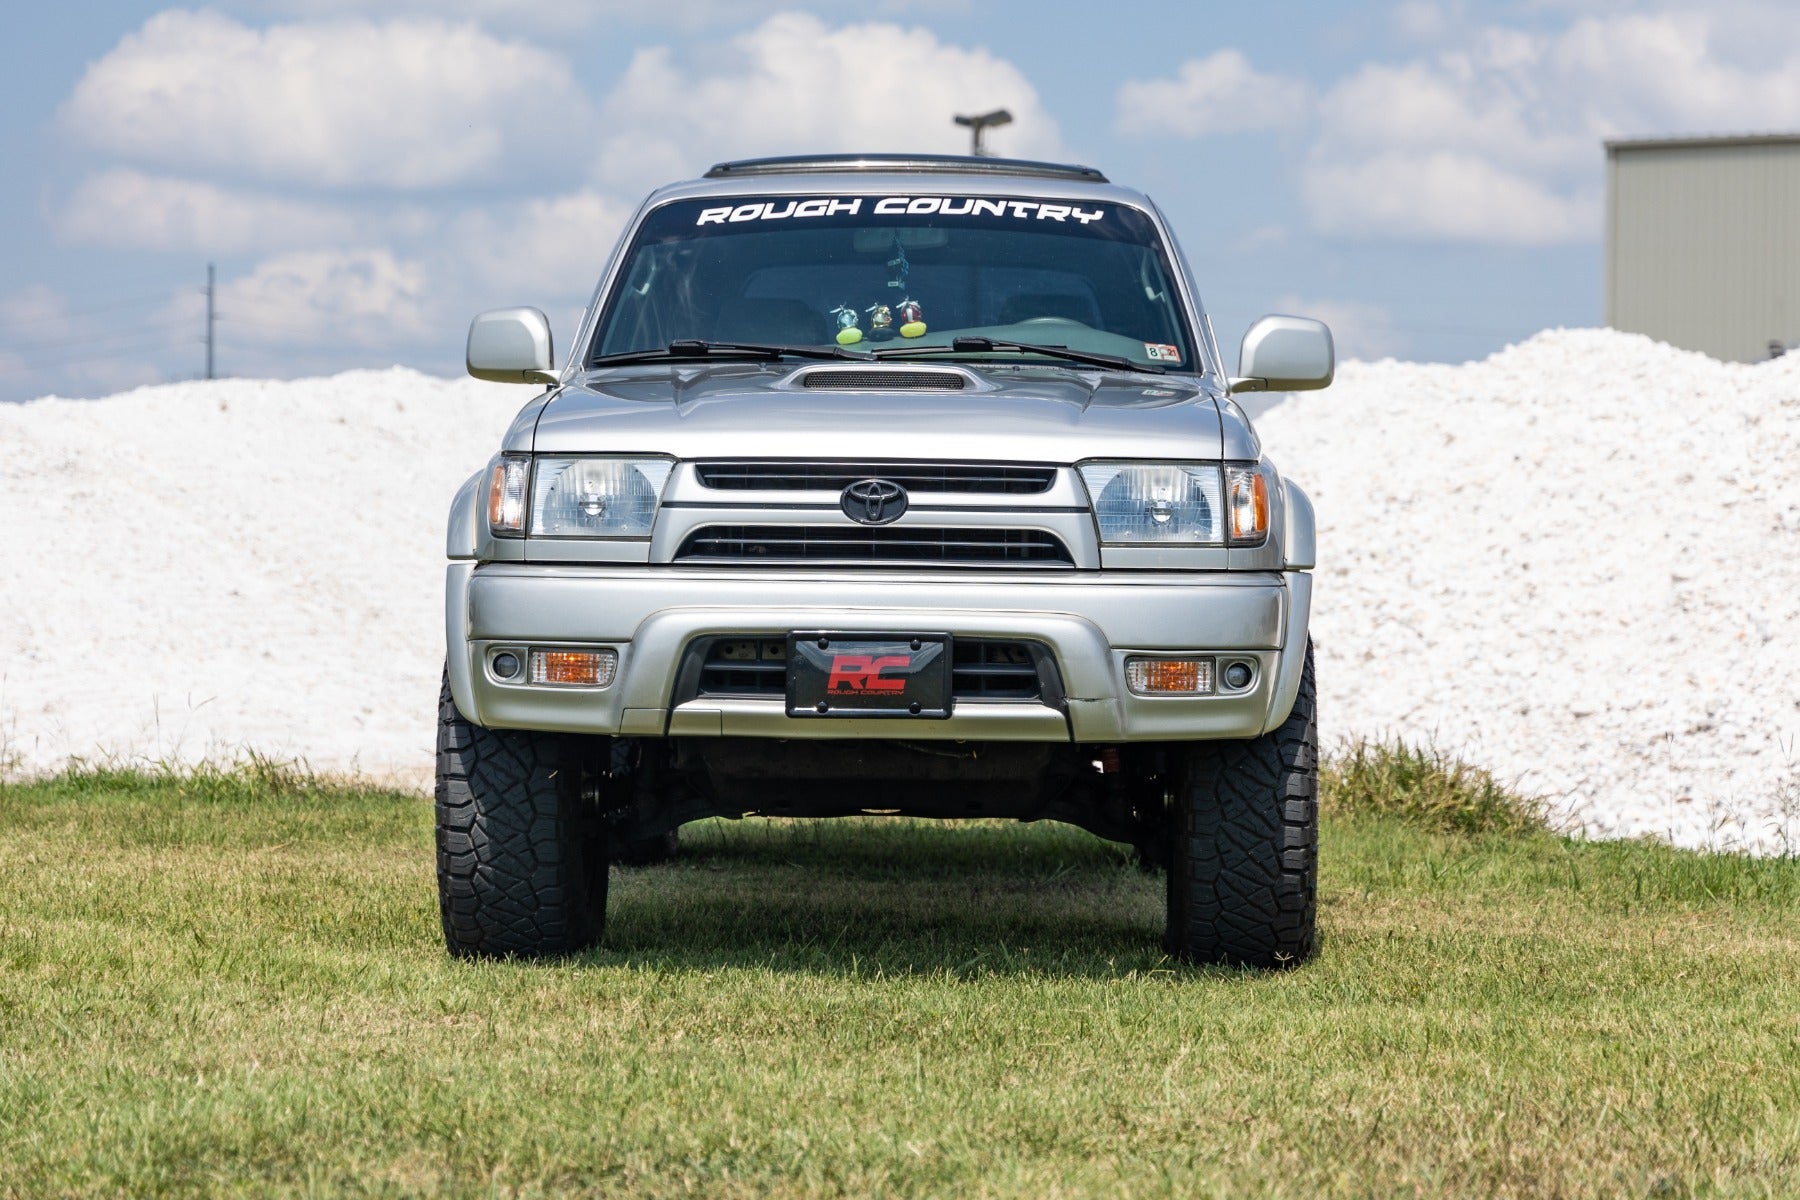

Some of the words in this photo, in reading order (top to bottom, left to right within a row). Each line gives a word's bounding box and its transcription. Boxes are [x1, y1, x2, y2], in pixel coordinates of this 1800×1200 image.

[696, 199, 863, 226] ROUGH
[873, 198, 1104, 225] COUNTRY
[1149, 347, 1158, 356] 8
[827, 655, 910, 689] RC
